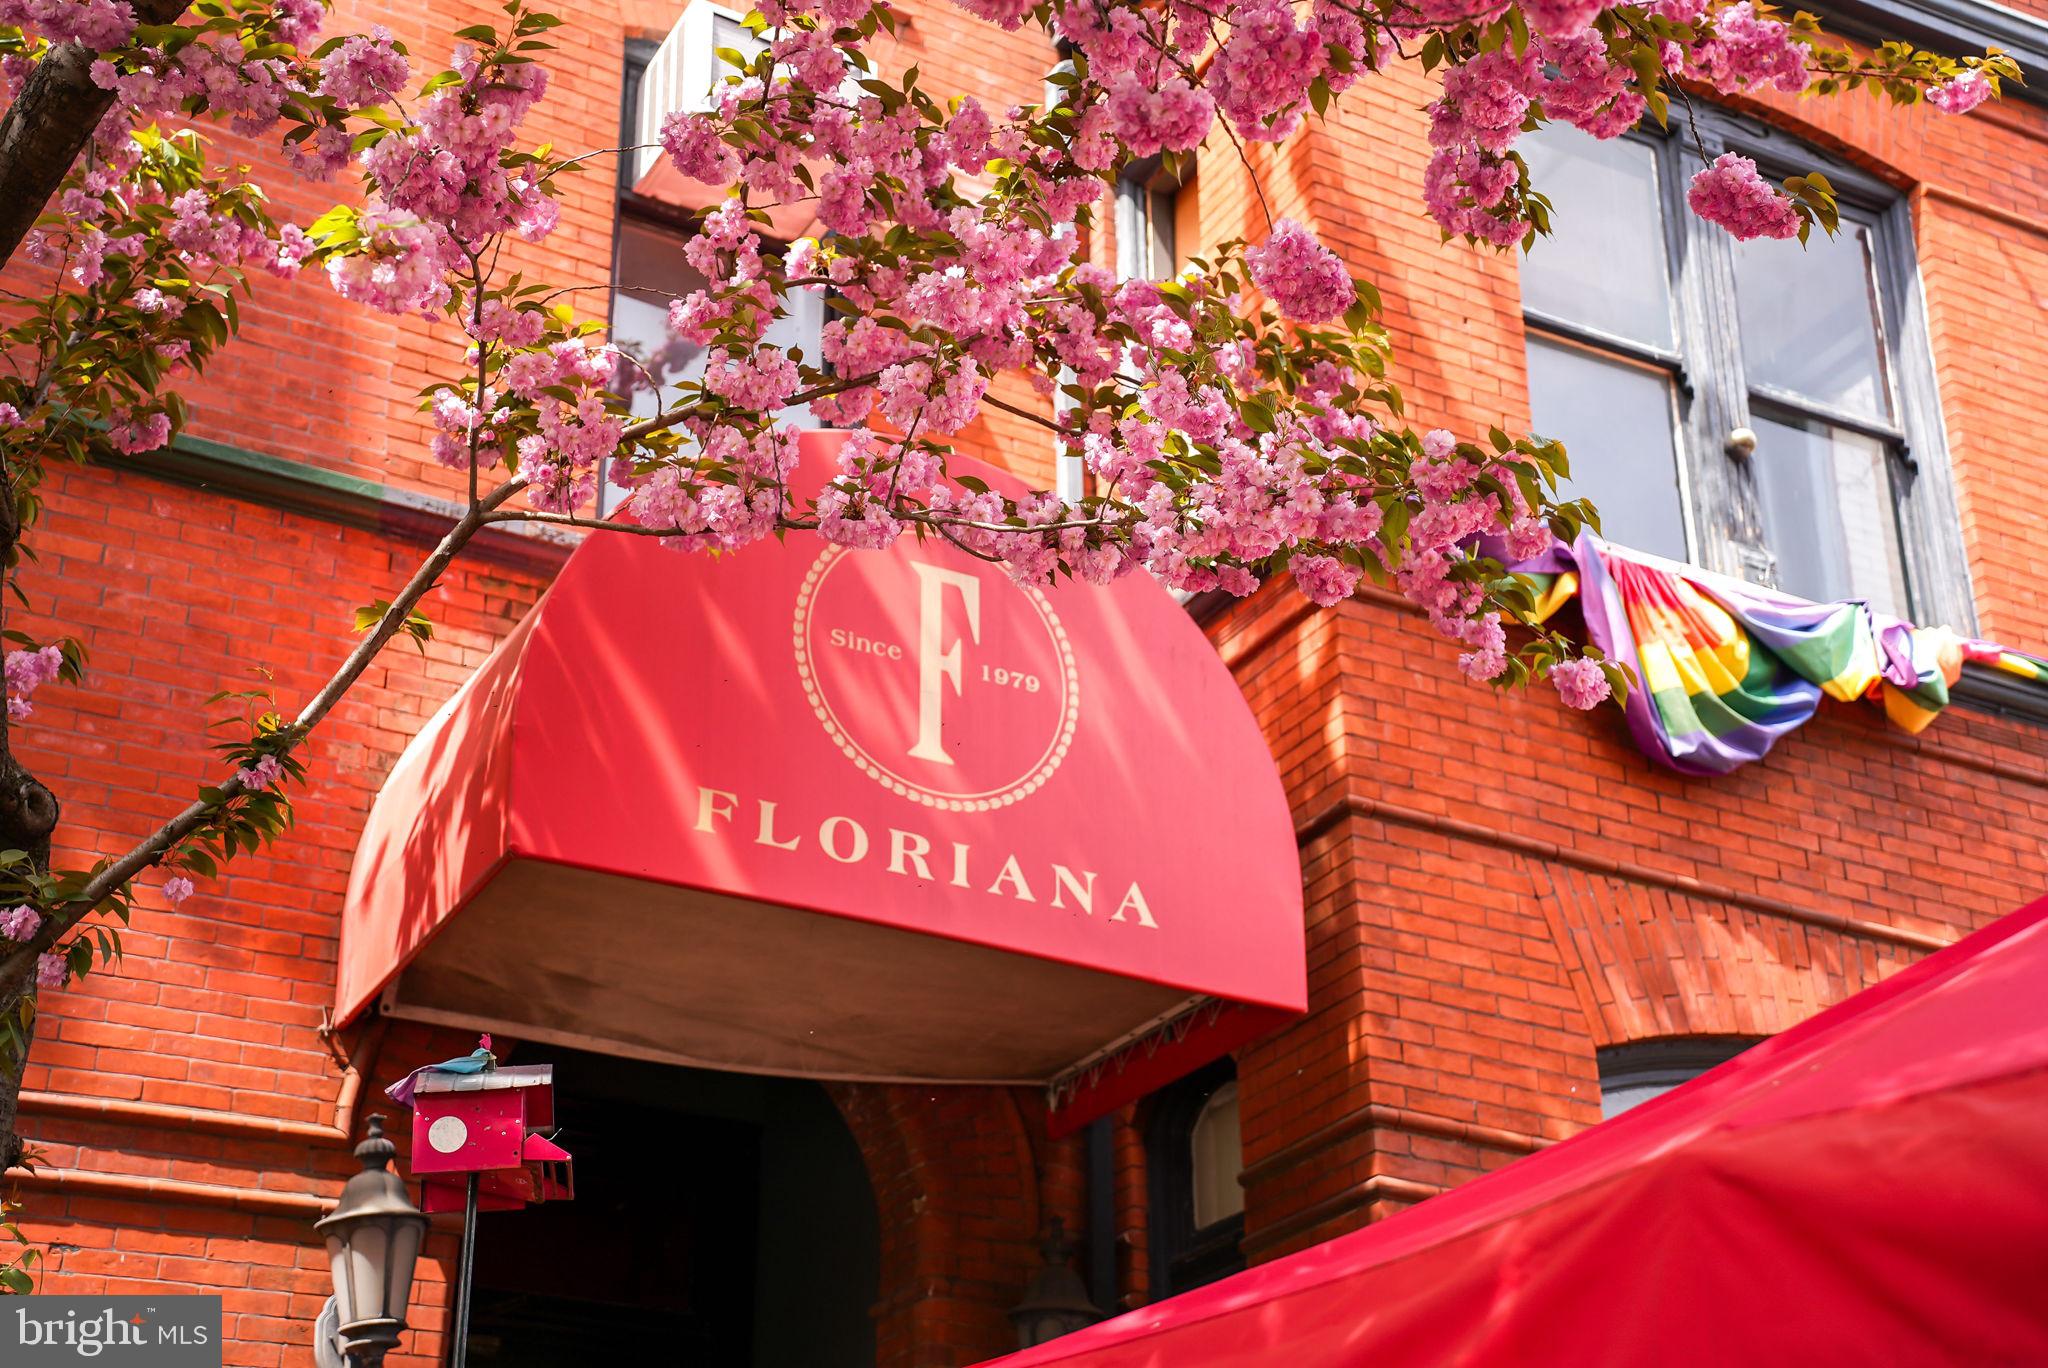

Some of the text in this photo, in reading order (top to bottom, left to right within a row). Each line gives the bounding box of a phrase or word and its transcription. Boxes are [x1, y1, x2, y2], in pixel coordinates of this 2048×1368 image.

[830, 628, 1041, 694] Since 1979
[908, 560, 981, 766] F
[693, 786, 1159, 929] FLORIANA
